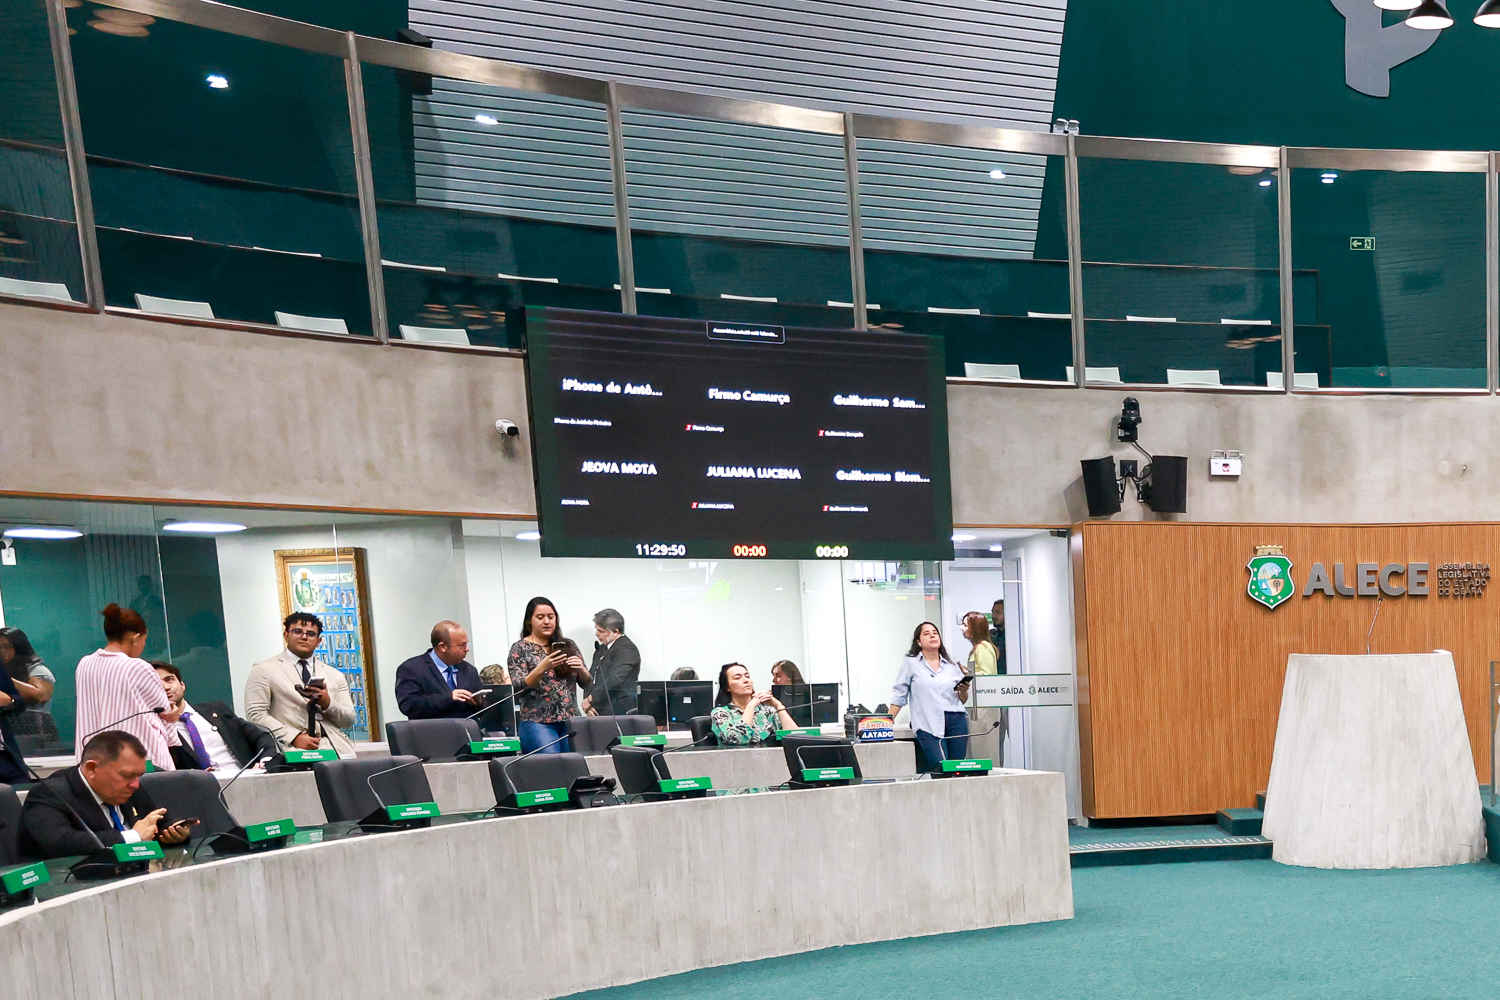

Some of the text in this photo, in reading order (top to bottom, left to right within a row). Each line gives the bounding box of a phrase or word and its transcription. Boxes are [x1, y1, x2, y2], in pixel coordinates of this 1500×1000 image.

[562, 378, 603, 392] iPhone
[605, 381, 621, 394] de
[708, 388, 790, 405] Firmo Camurça
[833, 394, 889, 408] Guilherme
[581, 460, 657, 475] JEOVA MOTA
[707, 466, 801, 480] JULIANA LUCENA
[835, 470, 891, 481] Guilherme
[635, 543, 849, 557] 11:29:50 00:00 00:00
[1302, 562, 1429, 597] ALECE
[1438, 570, 1491, 578] LEGISLATIVA
[1438, 579, 1487, 587] DO ESTADO
[1001, 685, 1024, 695] SAÍDA
[1037, 686, 1060, 694] ALECE
